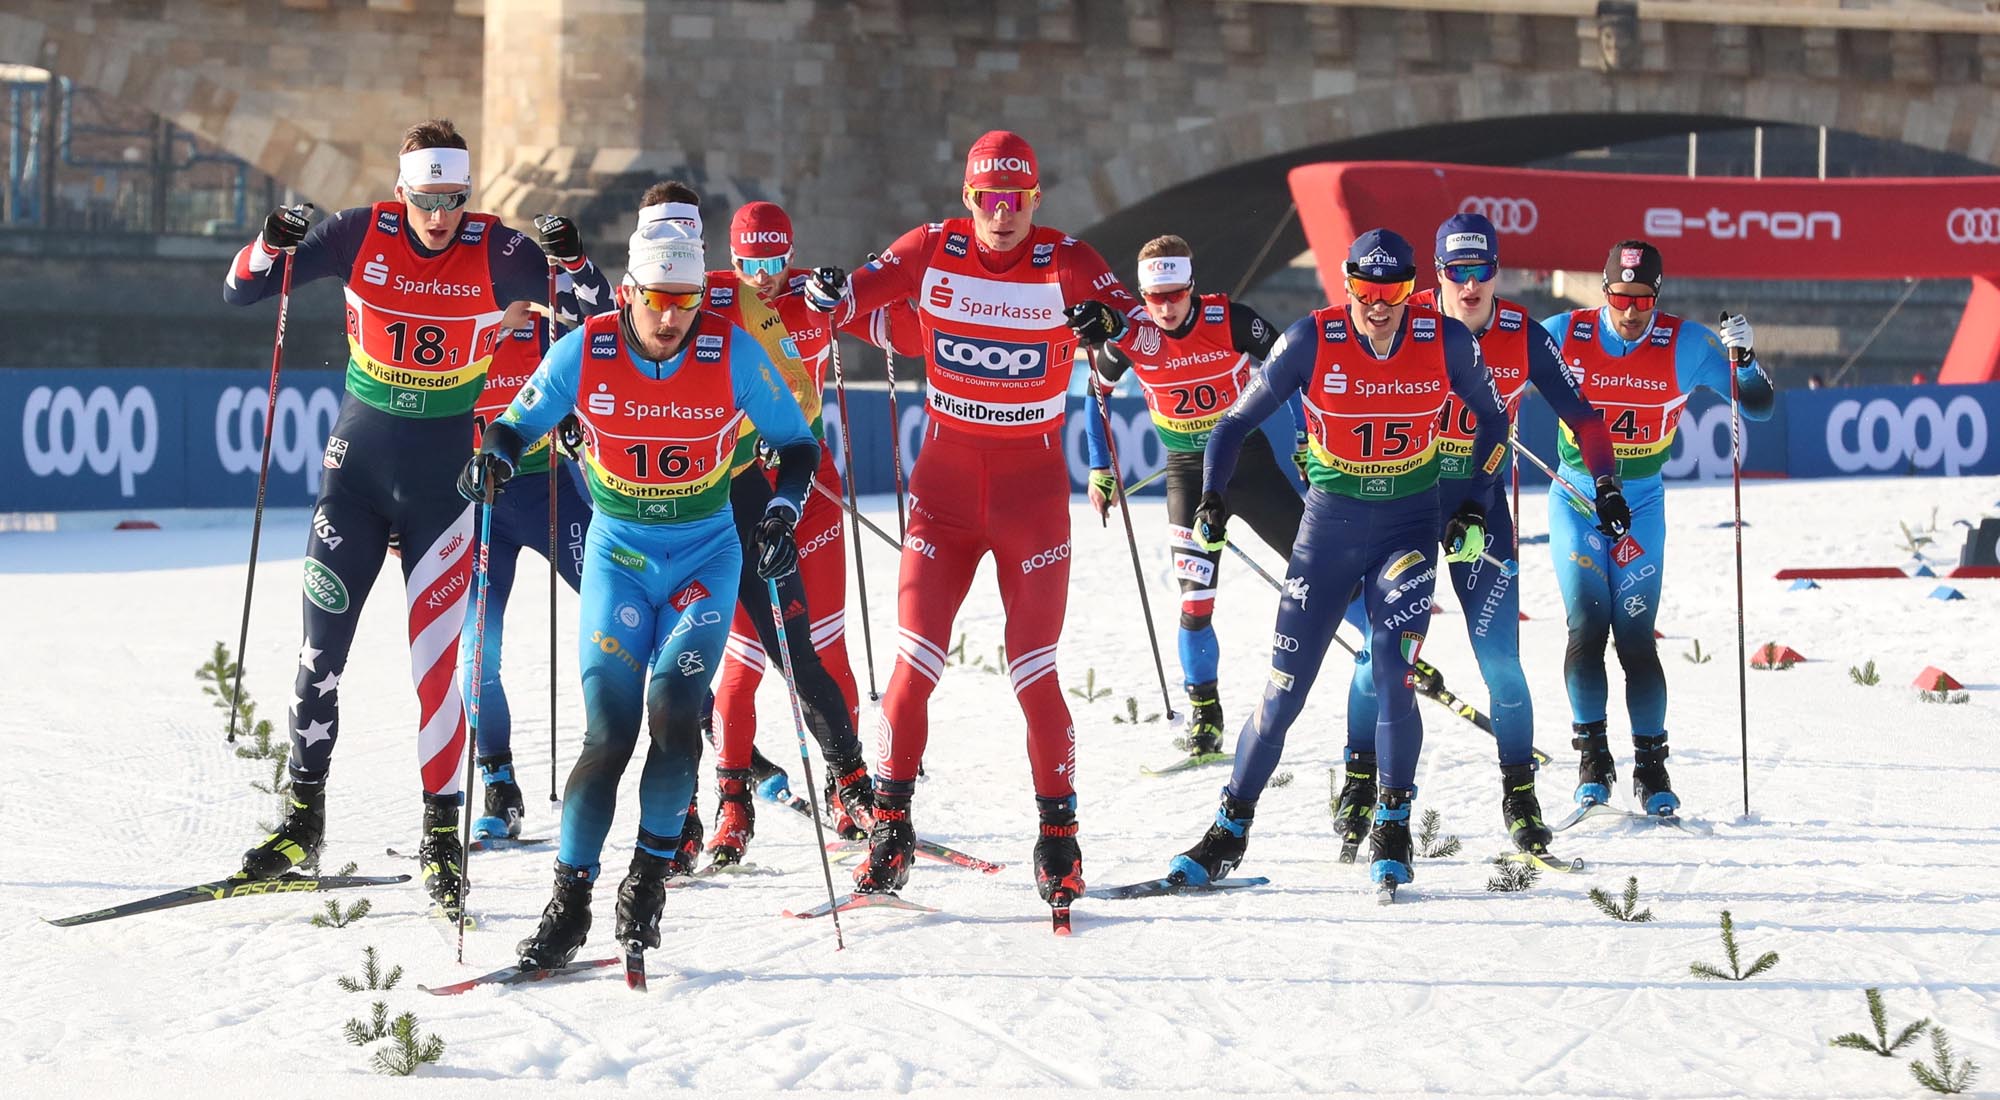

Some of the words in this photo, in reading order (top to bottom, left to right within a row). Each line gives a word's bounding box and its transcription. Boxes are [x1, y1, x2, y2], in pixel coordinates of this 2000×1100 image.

[973, 157, 1032, 175] LUKOIL
[377, 221, 398, 233] coop
[1644, 207, 1841, 240] e-tron
[461, 234, 482, 243] coop
[740, 232, 789, 244] LUKOIL
[945, 243, 967, 255] coop
[1032, 256, 1051, 264] coop
[393, 274, 481, 297] Sparkasse
[711, 298, 732, 306] coop
[959, 297, 1052, 320] Sparkasse
[1499, 320, 1521, 330] coop
[513, 331, 533, 339] coop
[1325, 331, 1347, 340] coop
[1414, 331, 1435, 339] coop
[1573, 330, 1592, 339] coop
[384, 321, 447, 366] 18
[448, 347, 459, 365] 1
[591, 347, 617, 356] coop
[696, 350, 721, 360] coop
[937, 338, 1040, 375] coop
[1061, 344, 1070, 361] 1
[1544, 336, 1576, 388] helvetia
[366, 360, 459, 388] #VisitDresden
[483, 374, 530, 390] arkass
[942, 371, 965, 383] CROSS
[965, 377, 1000, 388] COUNTRY
[1030, 379, 1046, 388] CUP
[1590, 373, 1668, 391] Sparkasse
[1354, 379, 1441, 398] Sparkasse
[396, 401, 417, 409] PLUS
[934, 392, 1045, 423] #VisitDresden
[1168, 384, 1217, 416] 20
[1220, 390, 1230, 403] 1
[623, 400, 725, 421] Sparkasse
[23, 386, 158, 497] coop
[1351, 421, 1414, 458] 15
[1640, 425, 1650, 441] 1
[1826, 395, 1988, 477] coop
[329, 437, 347, 451] US
[624, 443, 692, 479] 16
[1332, 457, 1423, 474] #VisitDresden
[313, 505, 344, 551] VISA
[438, 532, 465, 561] swix
[425, 571, 466, 609] xfinity
